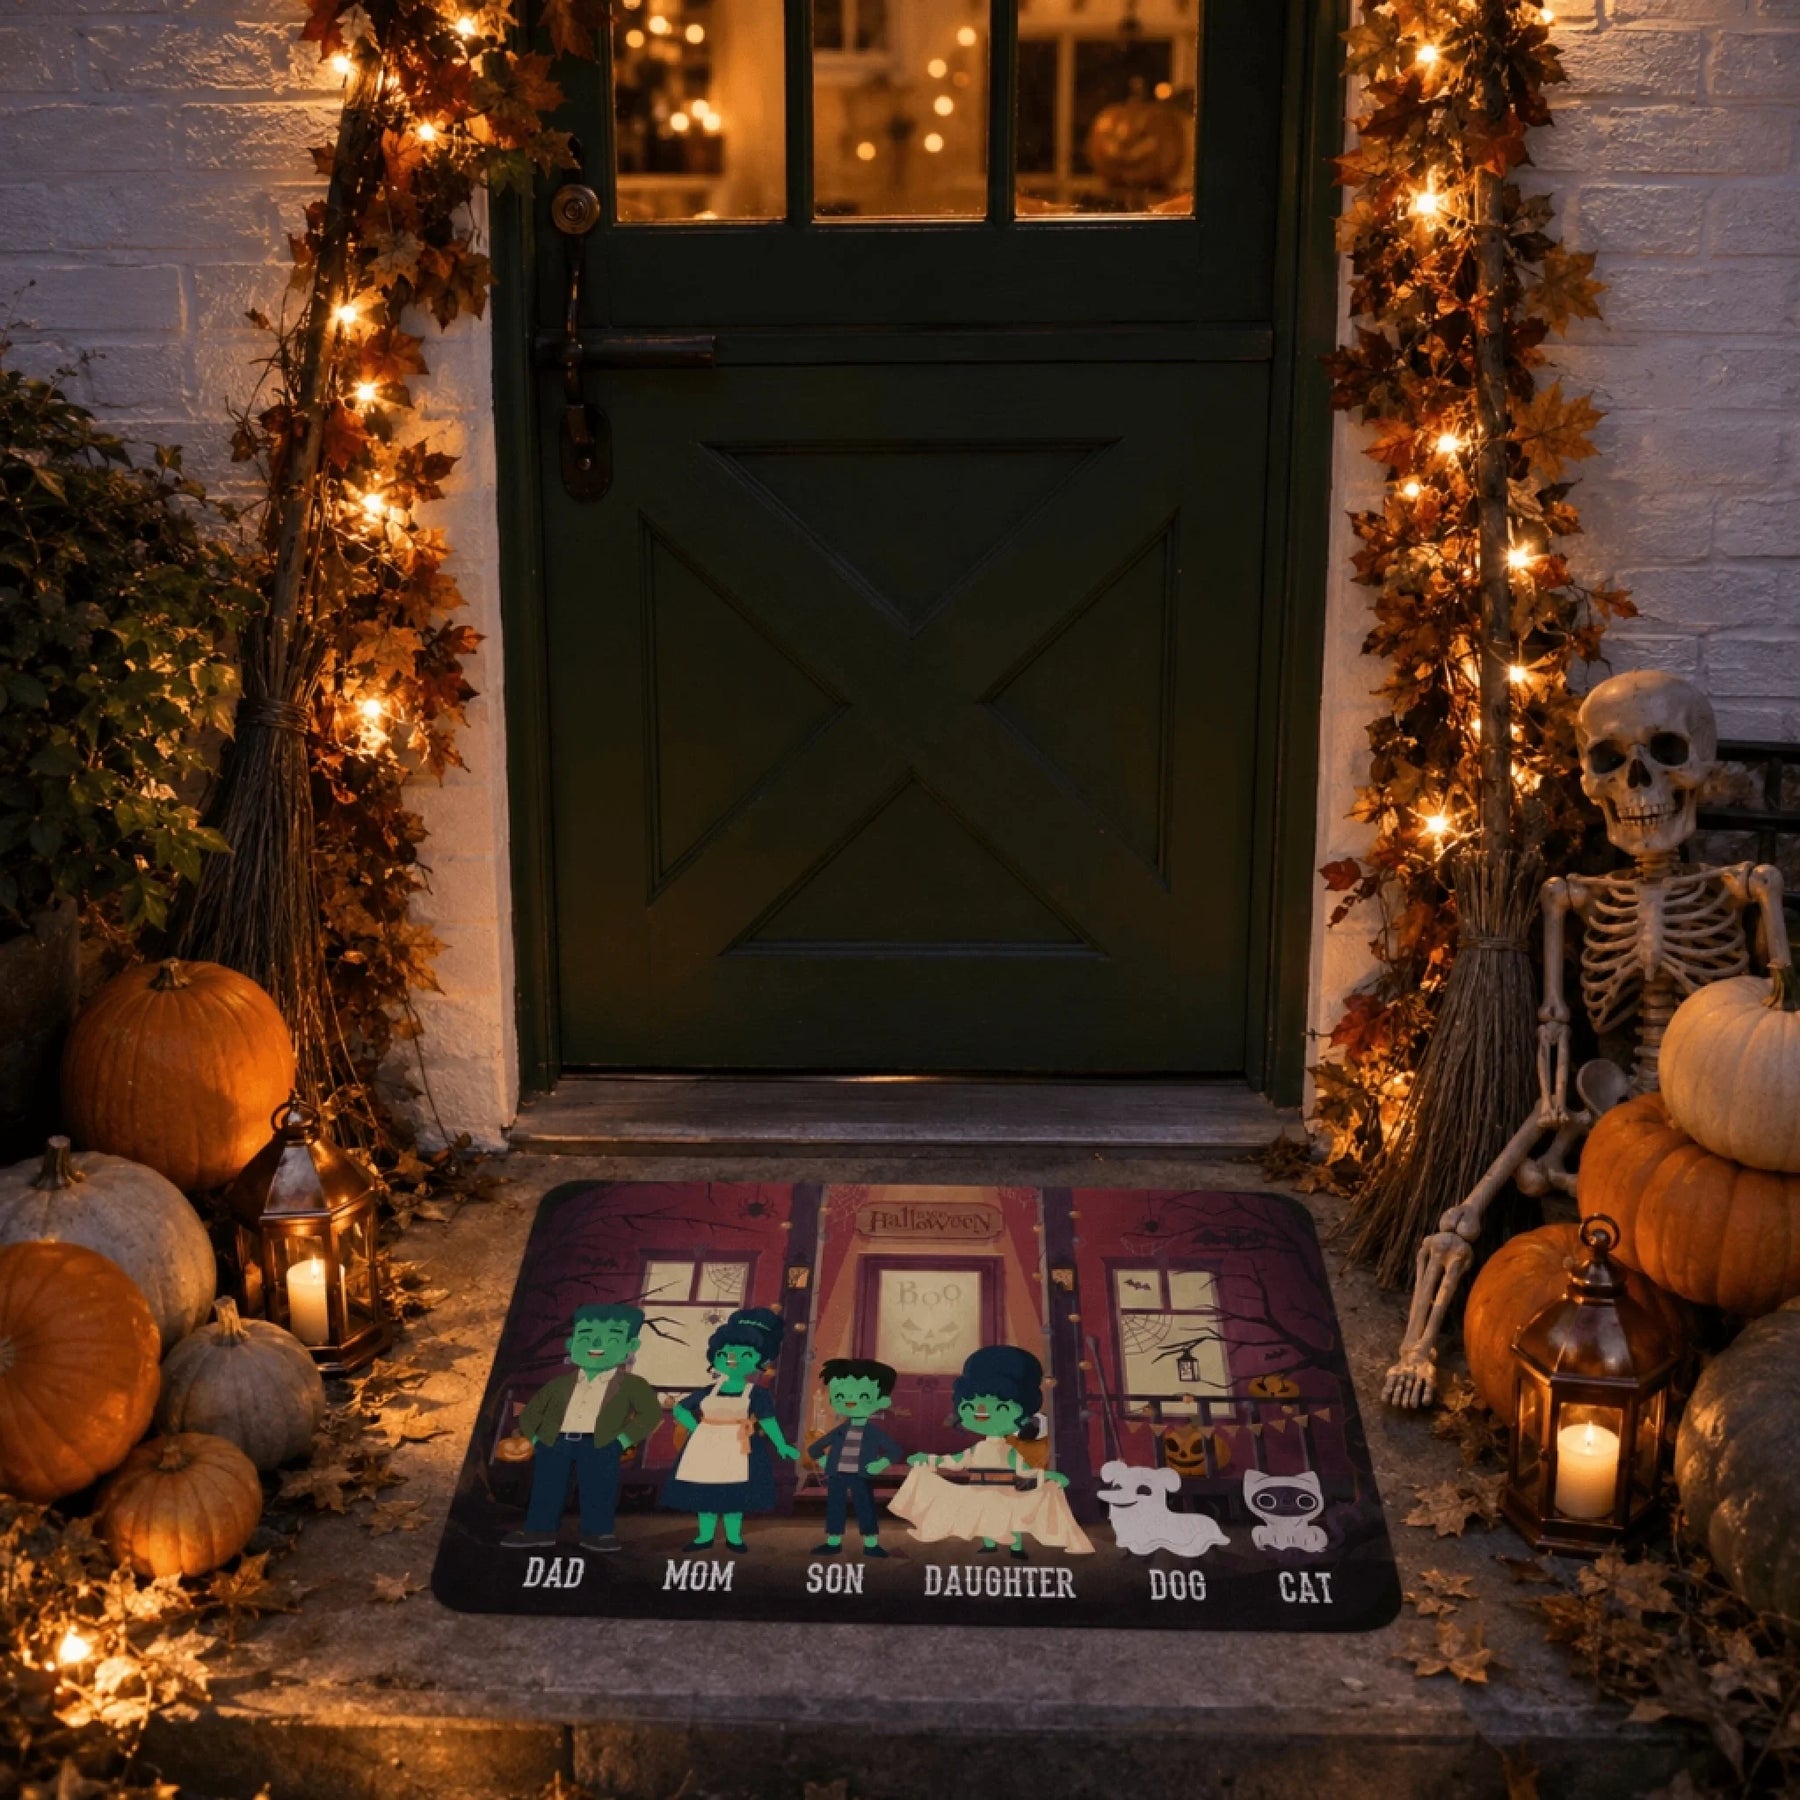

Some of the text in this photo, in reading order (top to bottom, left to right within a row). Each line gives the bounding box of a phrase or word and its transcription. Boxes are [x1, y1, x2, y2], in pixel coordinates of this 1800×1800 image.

[522, 1556, 585, 1588] DAD
[662, 1559, 735, 1591] MOM
[806, 1562, 866, 1594] SON
[923, 1565, 1077, 1598] DAUGHTER
[1149, 1569, 1207, 1600] DOG
[1279, 1571, 1334, 1604] CAT
